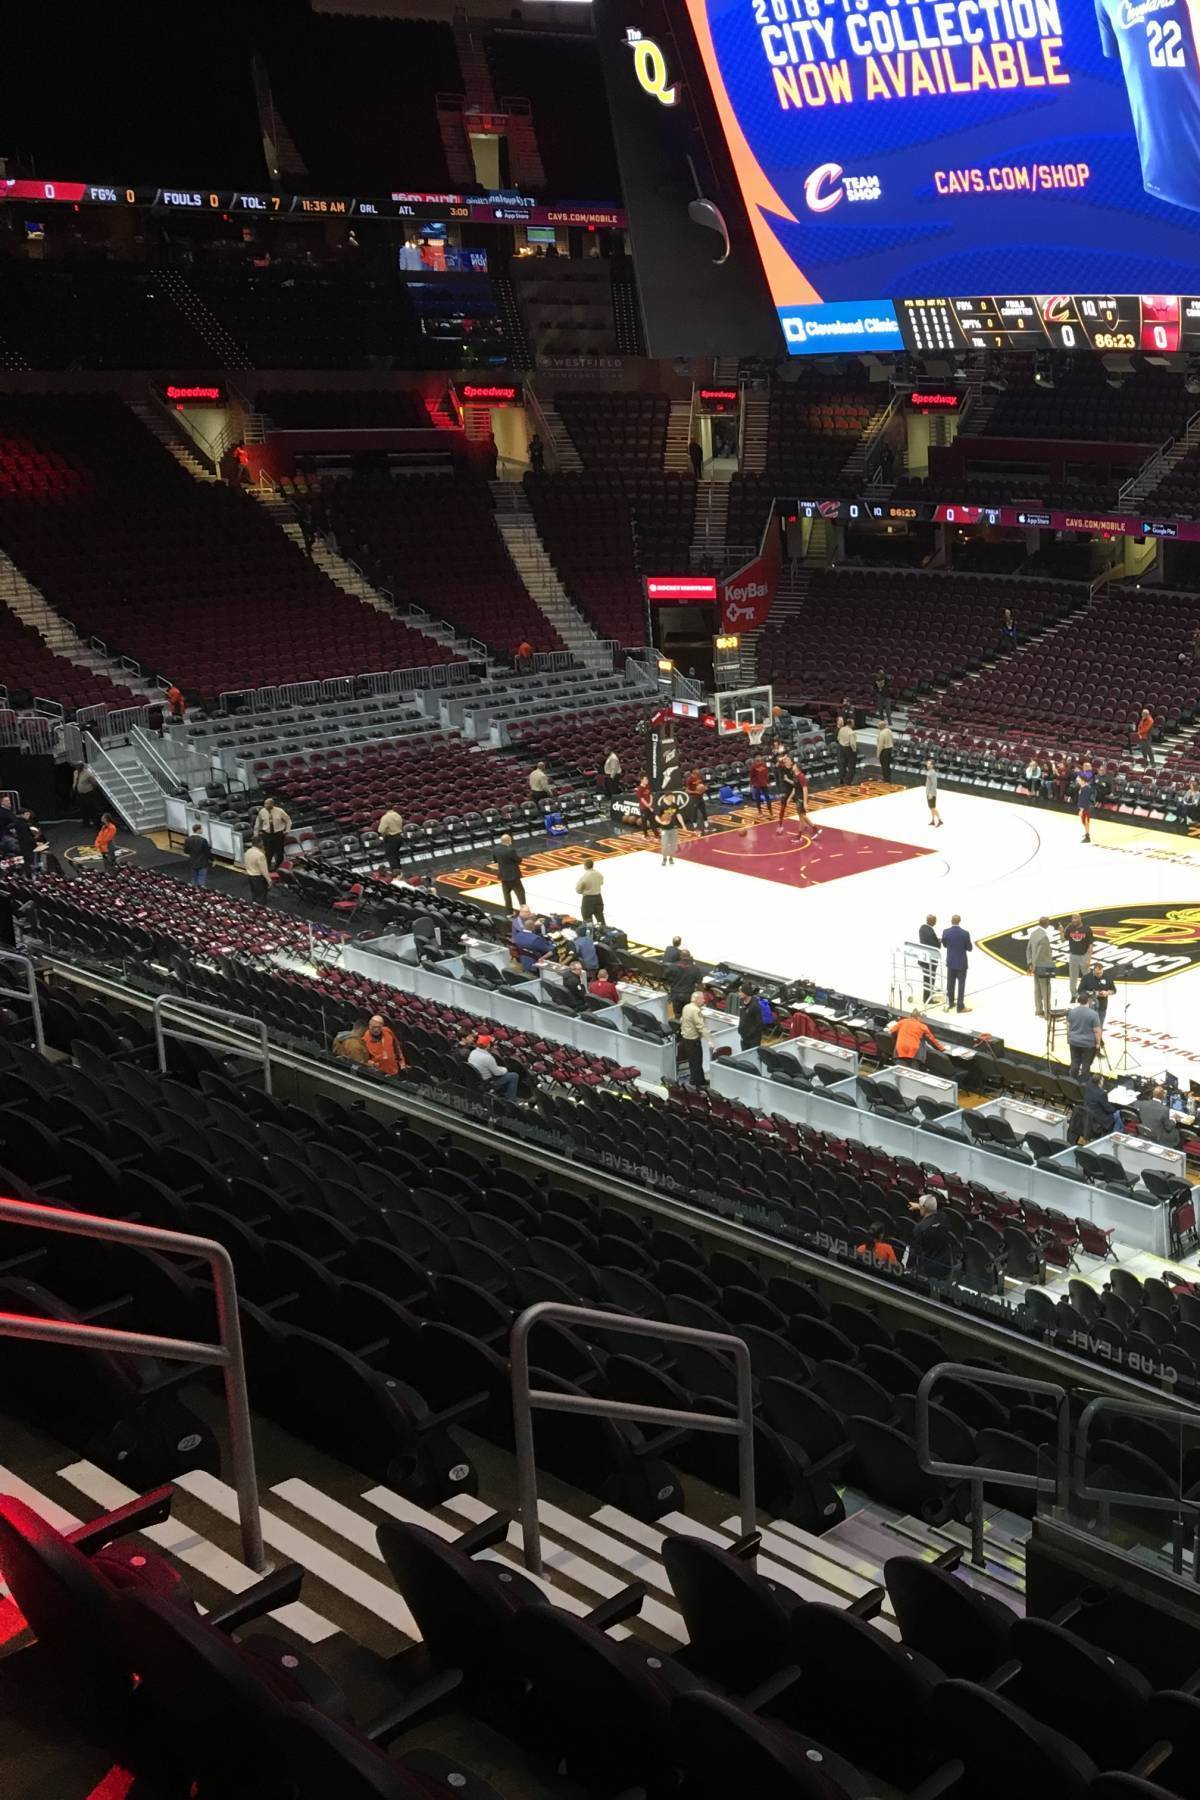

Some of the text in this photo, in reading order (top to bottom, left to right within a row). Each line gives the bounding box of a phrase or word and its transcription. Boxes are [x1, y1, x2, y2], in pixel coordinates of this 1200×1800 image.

[626, 28, 642, 41] The
[761, 0, 1062, 66] CITY COLLECTION
[1146, 20, 1186, 67] 22
[634, 39, 675, 105] Q
[773, 38, 1070, 109] NOW AVAILABLE
[842, 176, 880, 188] TEAM
[934, 163, 1090, 194] CAVS.COM/SHOP
[45, 184, 468, 217] 0 FG% 0 FOULS 0 TOL: 7 11:36 AM ORL ATL 3:00
[846, 188, 882, 201] SHOP
[548, 212, 617, 223] CAVS.COM/MOBILE
[805, 319, 864, 336] Cleveland
[864, 317, 899, 334] Clinic
[1061, 325, 1075, 347] 0
[1095, 334, 1135, 348] 86:23
[1153, 326, 1168, 349] 0
[167, 387, 219, 399] Speedway
[464, 386, 515, 398] Speedway
[701, 390, 737, 400] Speedway
[911, 394, 957, 405] Speedway
[806, 507, 812, 518] 0
[850, 505, 858, 518] 0
[946, 509, 955, 521] 0
[989, 514, 996, 525] 0
[1066, 518, 1126, 531] CAVS.COM/MOBILE
[1107, 1019, 1178, 1042] Arena
